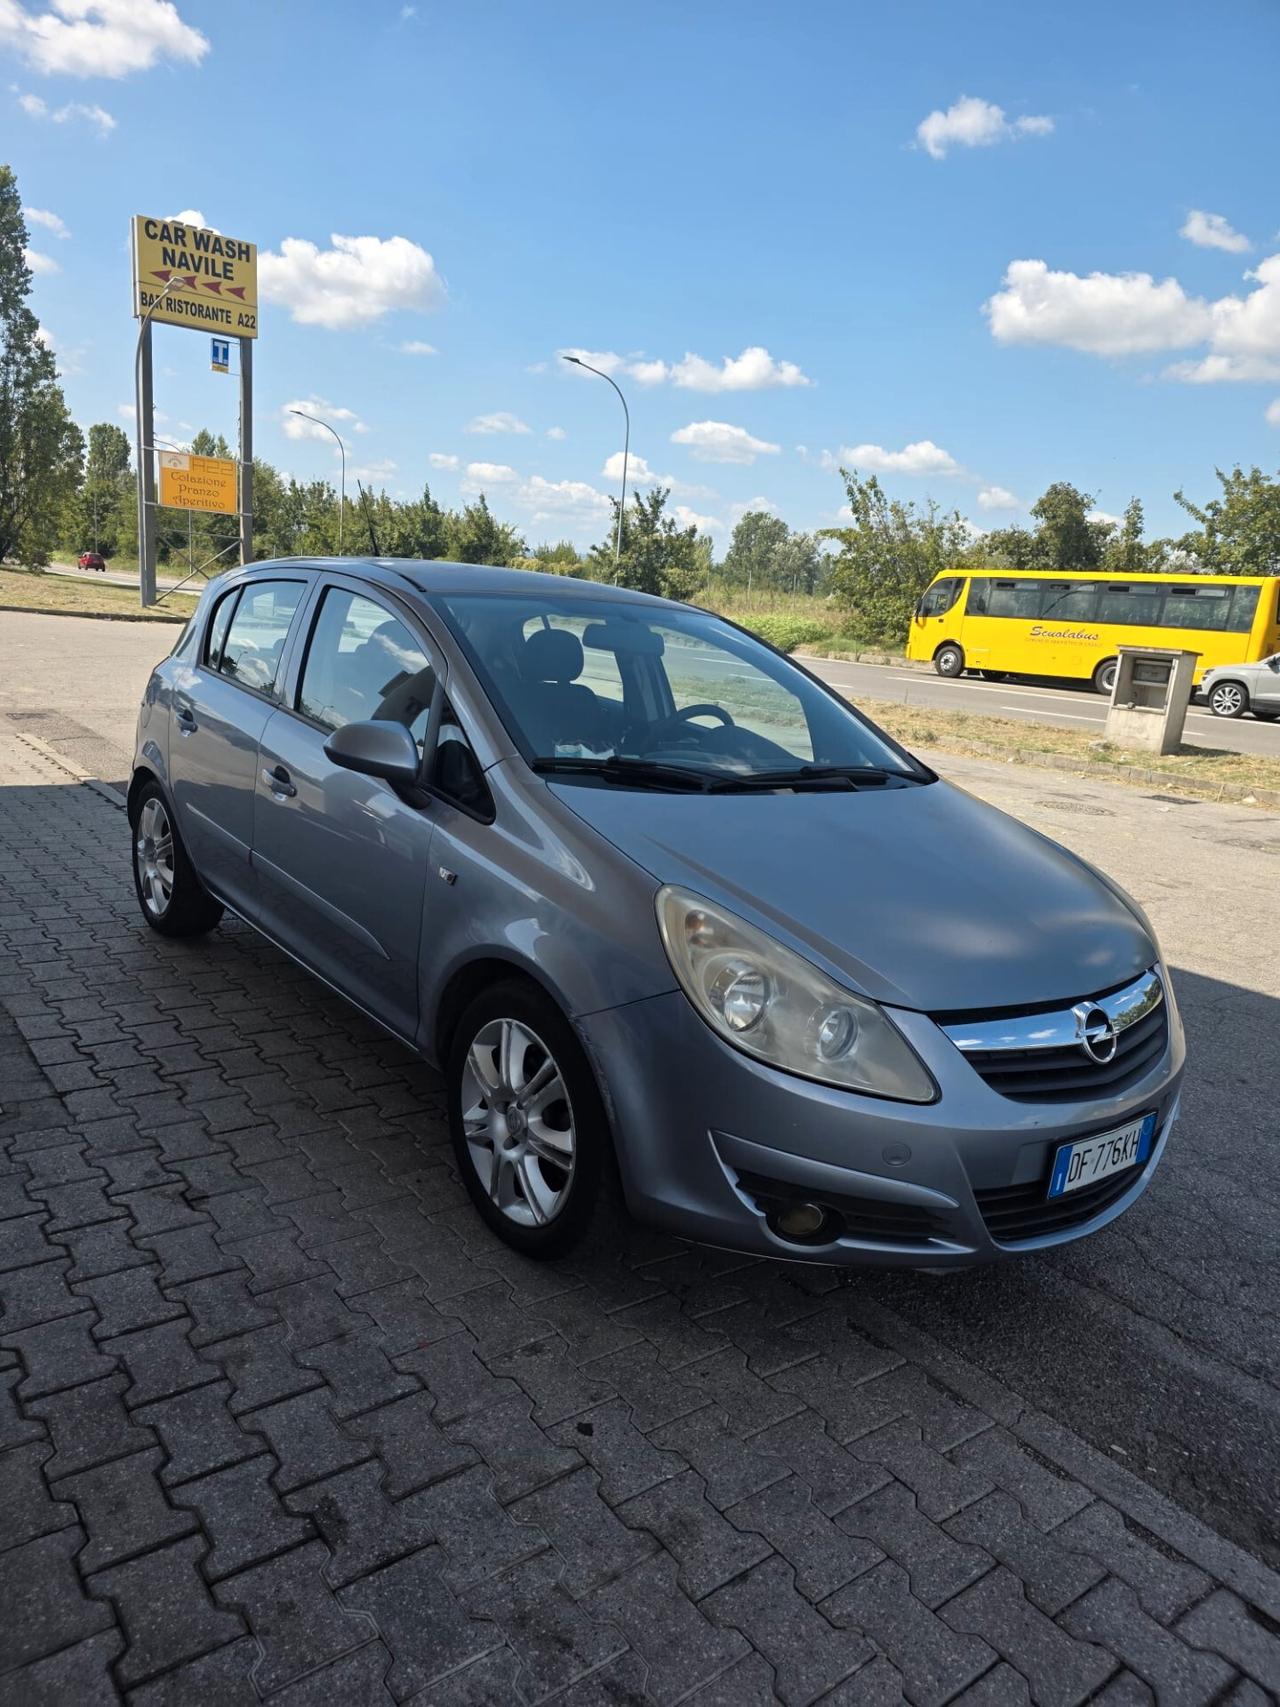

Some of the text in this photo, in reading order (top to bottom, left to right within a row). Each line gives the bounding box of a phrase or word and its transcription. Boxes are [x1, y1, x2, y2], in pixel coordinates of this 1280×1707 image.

[144, 220, 251, 263] CAR WASH
[162, 247, 234, 281] NAVILE
[140, 291, 256, 329] BAR RISTORANTE A22
[171, 471, 227, 488] Colazione
[178, 483, 220, 498] Pranzo
[172, 495, 226, 509] Aperitivo
[1029, 625, 1099, 641] Scuolabus
[1067, 1148, 1093, 1183] DF
[1092, 1128, 1142, 1175] 776KH
